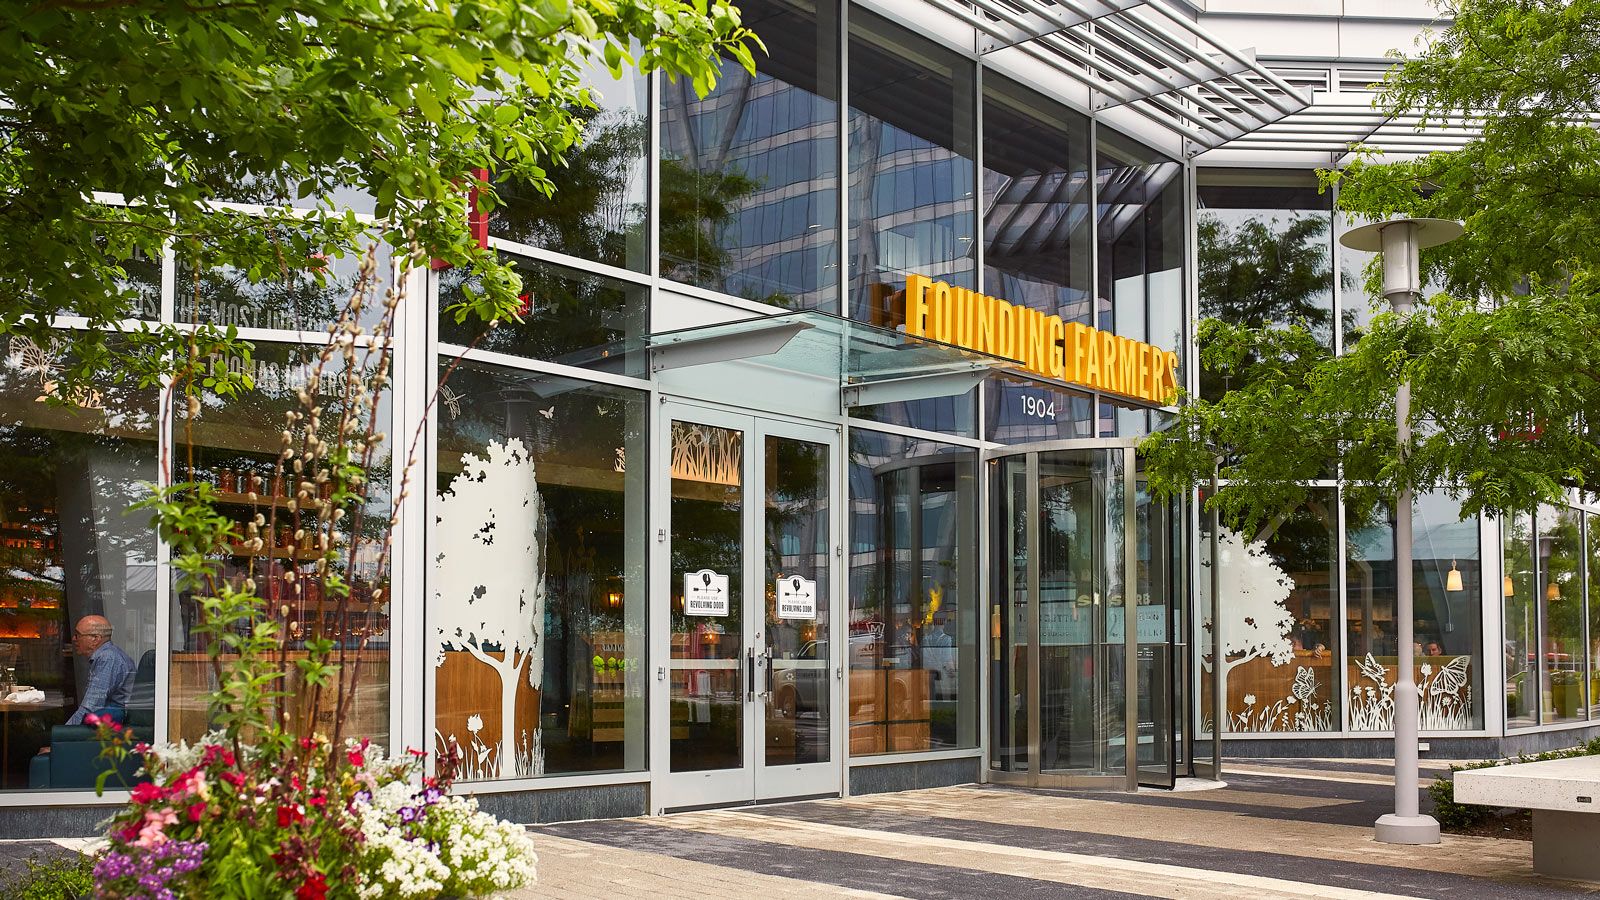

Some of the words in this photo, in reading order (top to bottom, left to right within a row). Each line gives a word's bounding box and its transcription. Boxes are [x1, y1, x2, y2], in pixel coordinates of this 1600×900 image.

[906, 274, 1064, 379] FOUNDING
[1064, 321, 1179, 406] FARMERS
[1021, 395, 1055, 420] 1904
[690, 600, 712, 609] REVOLVING
[713, 601, 724, 609] DOOR
[782, 604, 802, 613] REVOLVING
[802, 605, 813, 613] DOOR
